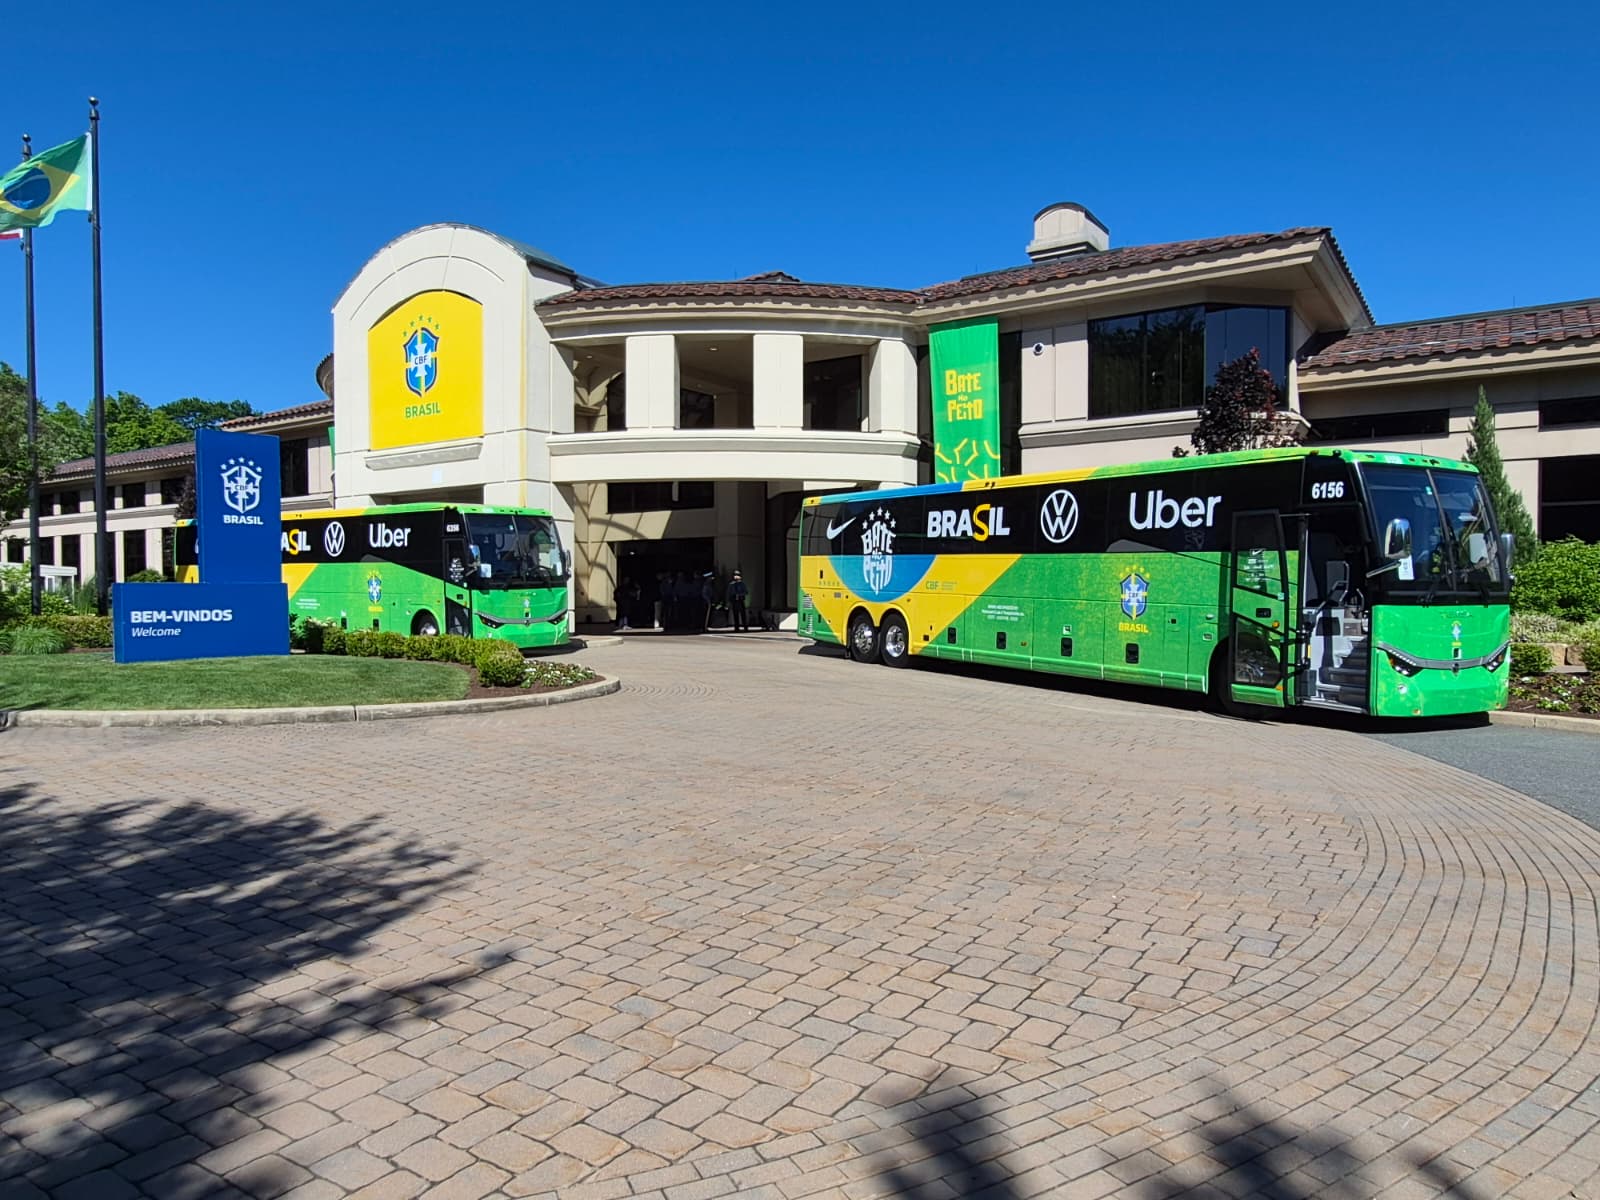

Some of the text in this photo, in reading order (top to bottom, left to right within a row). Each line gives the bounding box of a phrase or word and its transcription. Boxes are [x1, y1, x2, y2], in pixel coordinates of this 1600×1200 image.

[414, 355, 428, 365] CBF
[945, 369, 982, 396] BATE
[405, 402, 441, 418] BRASIL
[1311, 481, 1344, 499] 6156
[223, 514, 264, 525] BRASIL
[927, 503, 1011, 542] BRASIL
[1042, 490, 1078, 542] VW
[1129, 489, 1222, 531] Uber
[281, 528, 311, 555] ASIL
[325, 521, 345, 557] VW
[369, 523, 411, 548] Uber
[861, 520, 897, 555] BATE
[130, 609, 233, 623] BEM-VINDOS
[1119, 622, 1149, 634] BRASIL
[131, 626, 182, 637] Welcome
